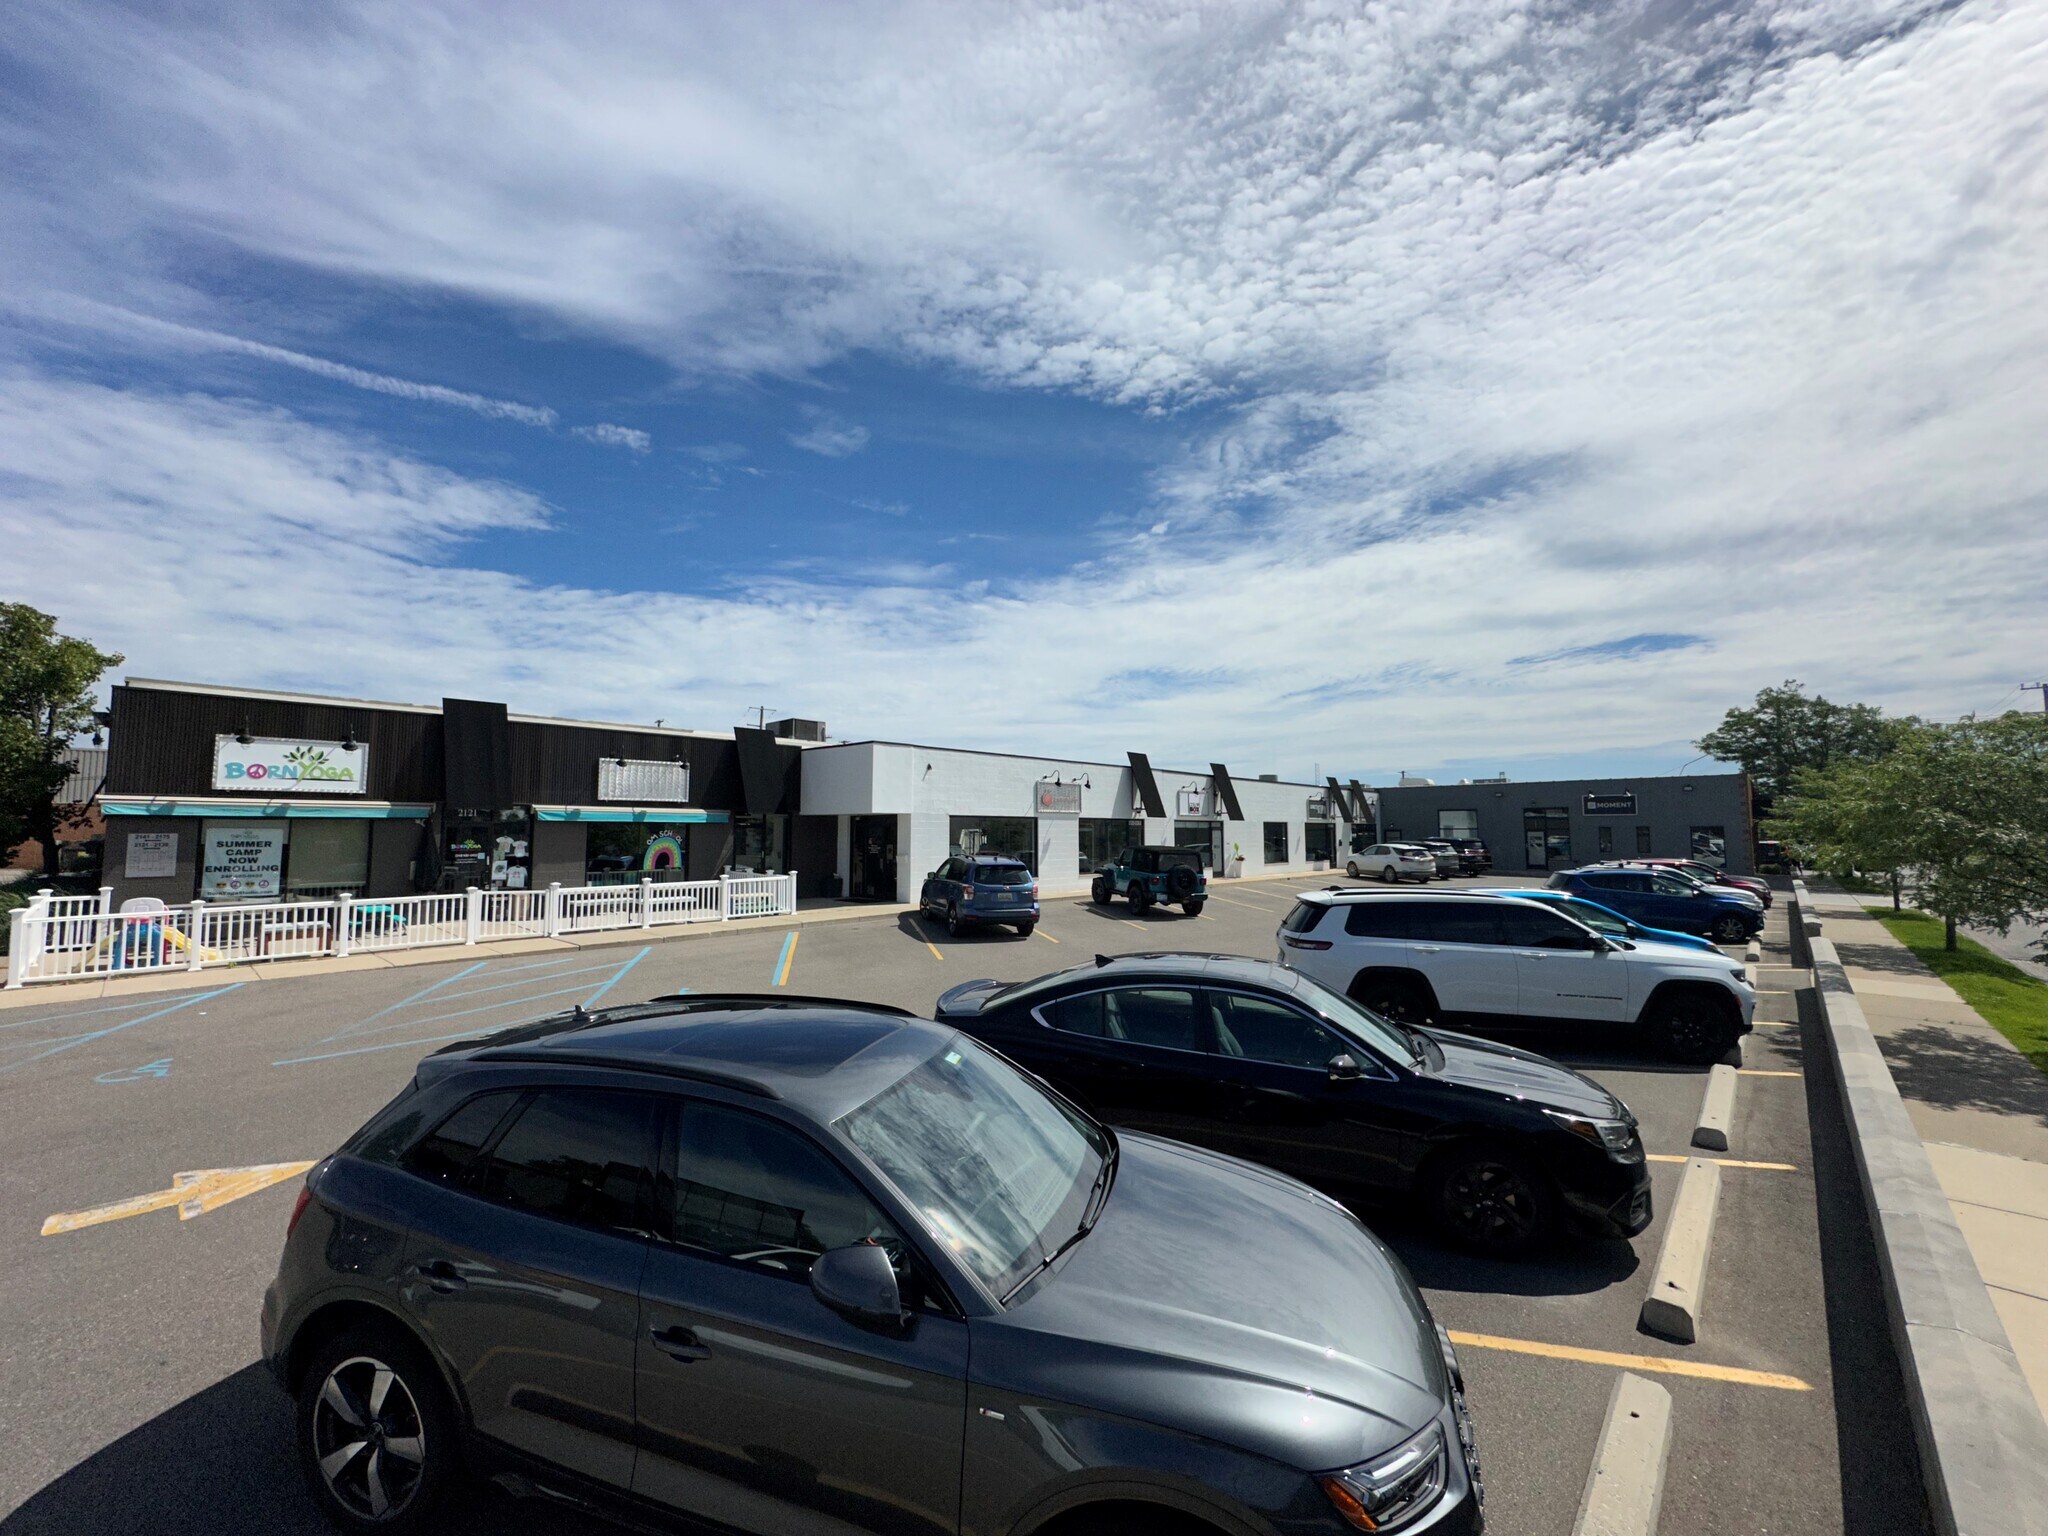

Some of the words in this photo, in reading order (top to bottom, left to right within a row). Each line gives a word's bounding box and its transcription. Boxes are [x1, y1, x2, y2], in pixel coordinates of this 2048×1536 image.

[457, 809, 477, 817] 2121
[646, 834, 658, 845] OM
[205, 865, 279, 873] ENROLLING
